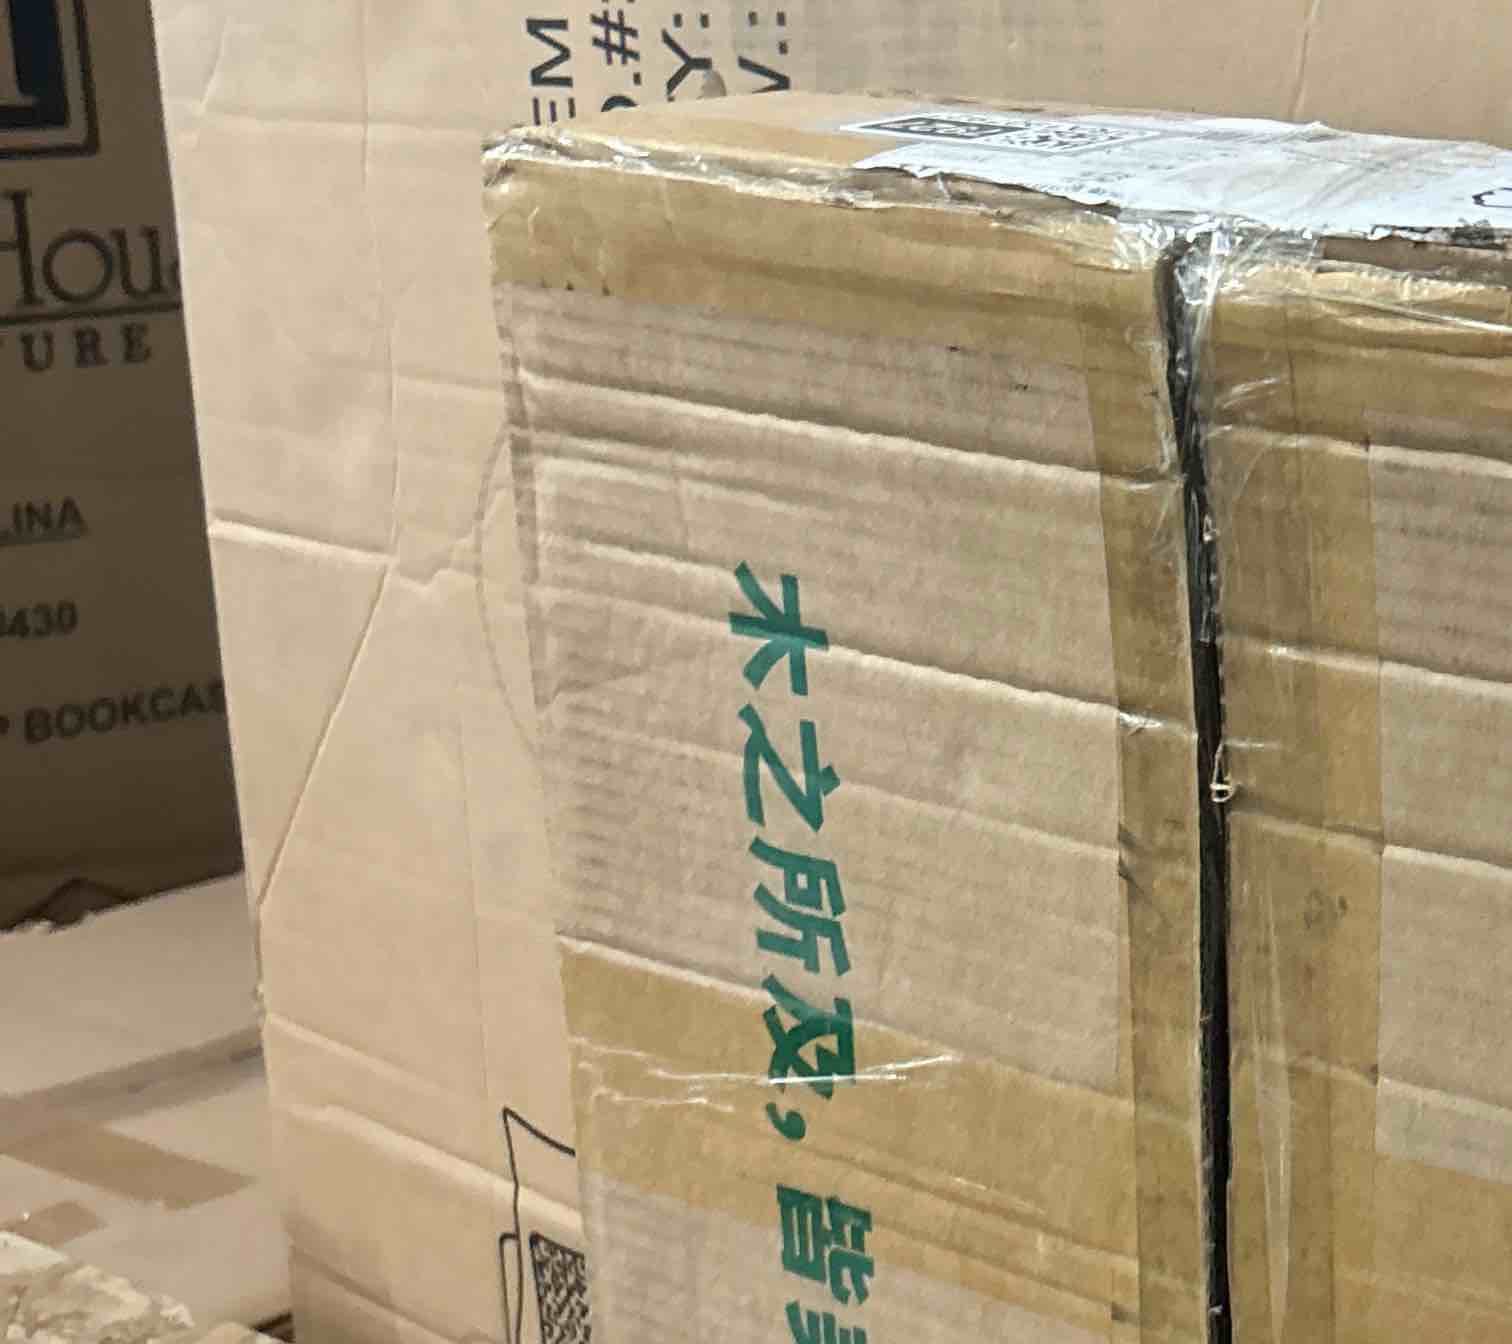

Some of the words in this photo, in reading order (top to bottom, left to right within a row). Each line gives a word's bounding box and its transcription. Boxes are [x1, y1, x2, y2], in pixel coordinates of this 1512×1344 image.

[661, 11, 713, 102] Y:
[0, 323, 153, 372] URE
[0, 495, 90, 536] INA
[0, 601, 79, 639] 430
